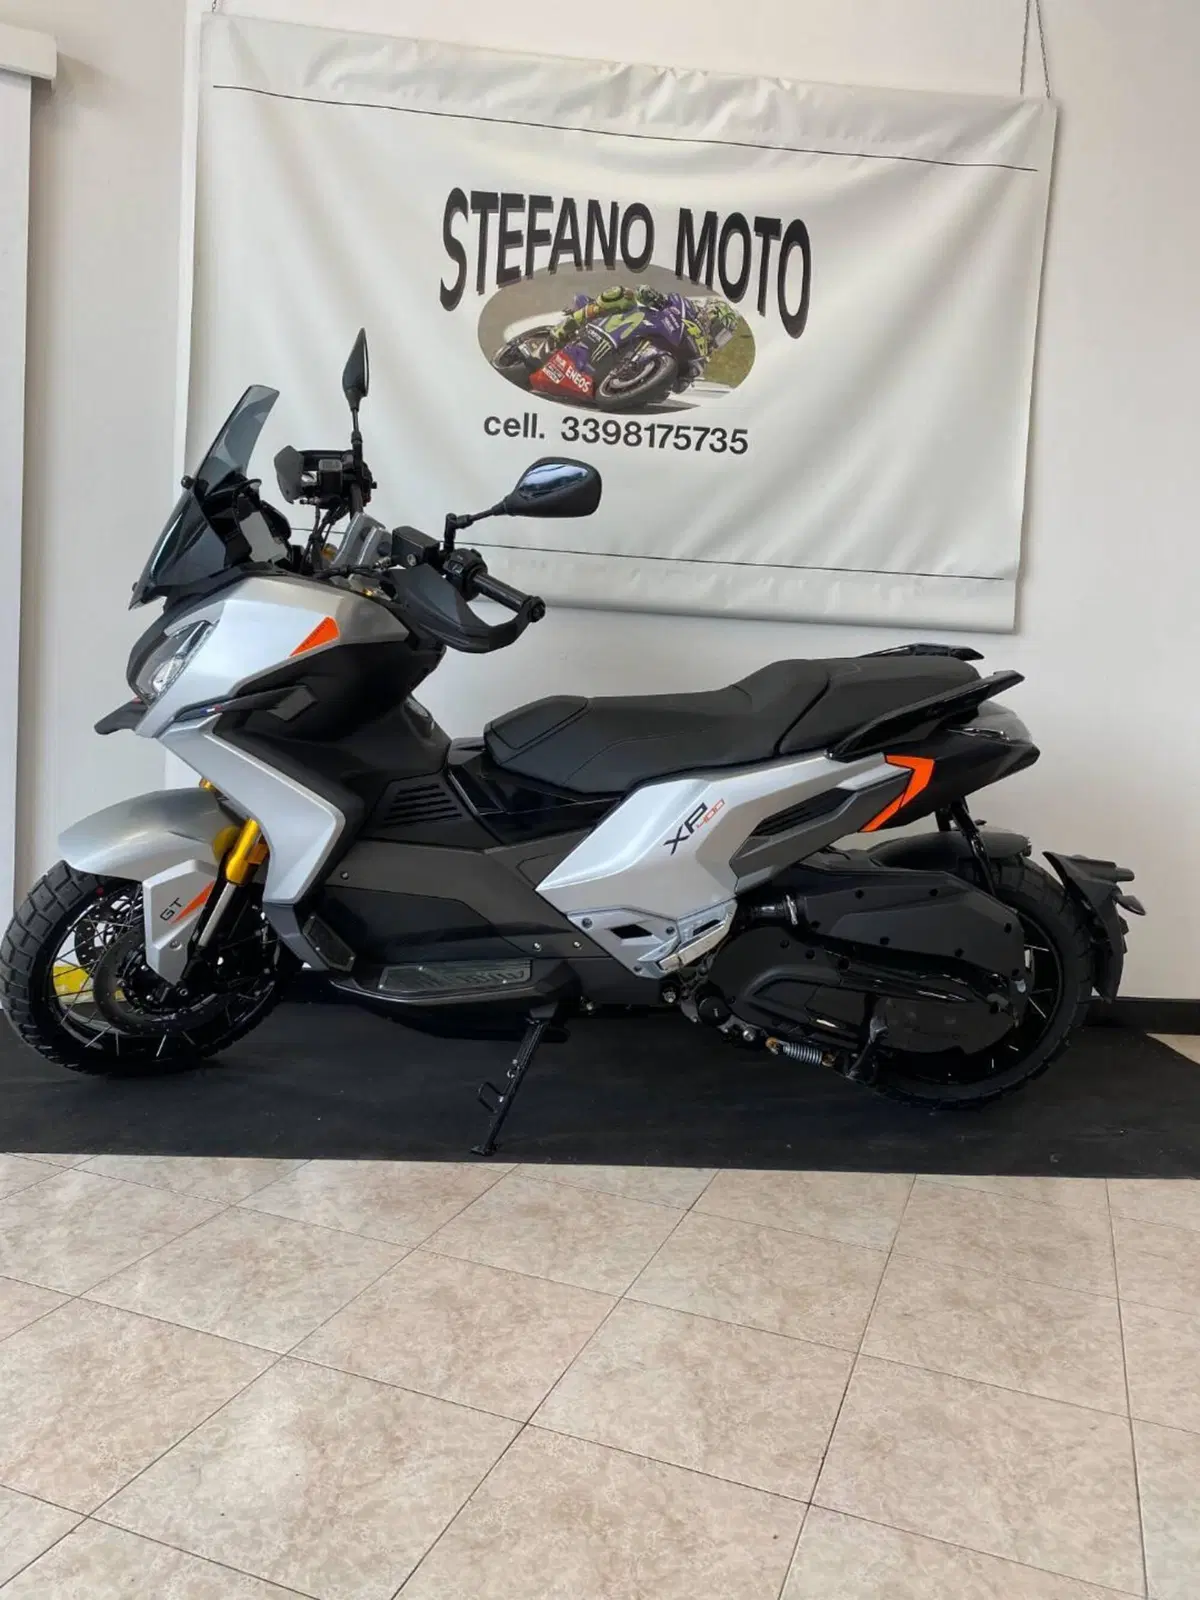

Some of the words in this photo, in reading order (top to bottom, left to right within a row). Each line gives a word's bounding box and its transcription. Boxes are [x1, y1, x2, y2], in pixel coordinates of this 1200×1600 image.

[439, 186, 655, 311] STEFANO
[674, 207, 812, 339] MOTO
[565, 365, 592, 393] ENEOS
[483, 412, 545, 439] cell.
[560, 416, 749, 455] 3398175735
[159, 897, 182, 921] GT
